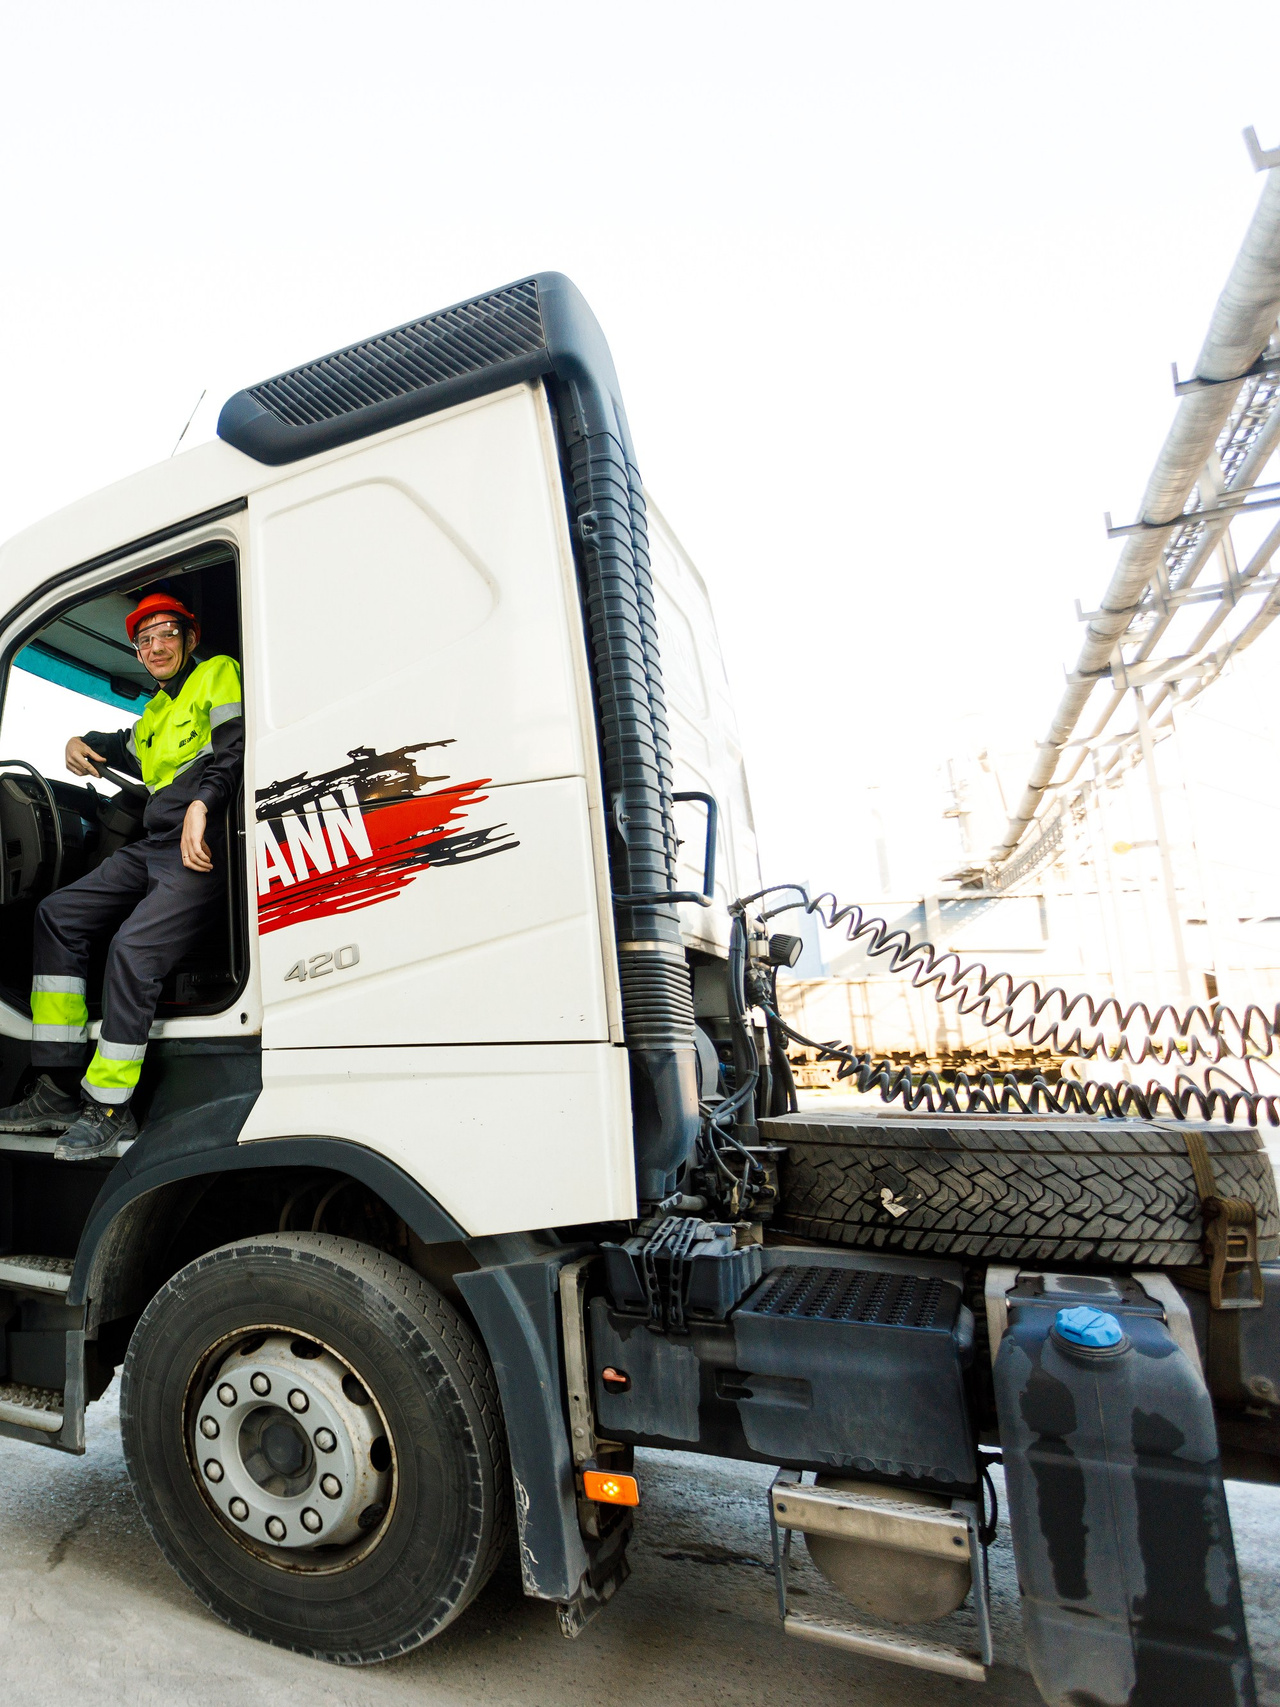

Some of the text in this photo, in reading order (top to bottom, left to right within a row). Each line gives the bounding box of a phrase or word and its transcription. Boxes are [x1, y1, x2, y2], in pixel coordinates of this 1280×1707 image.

[283, 942, 361, 983] 420
[305, 1290, 435, 1443] YOKOHAMA
[817, 1449, 957, 1484] VOLVO
